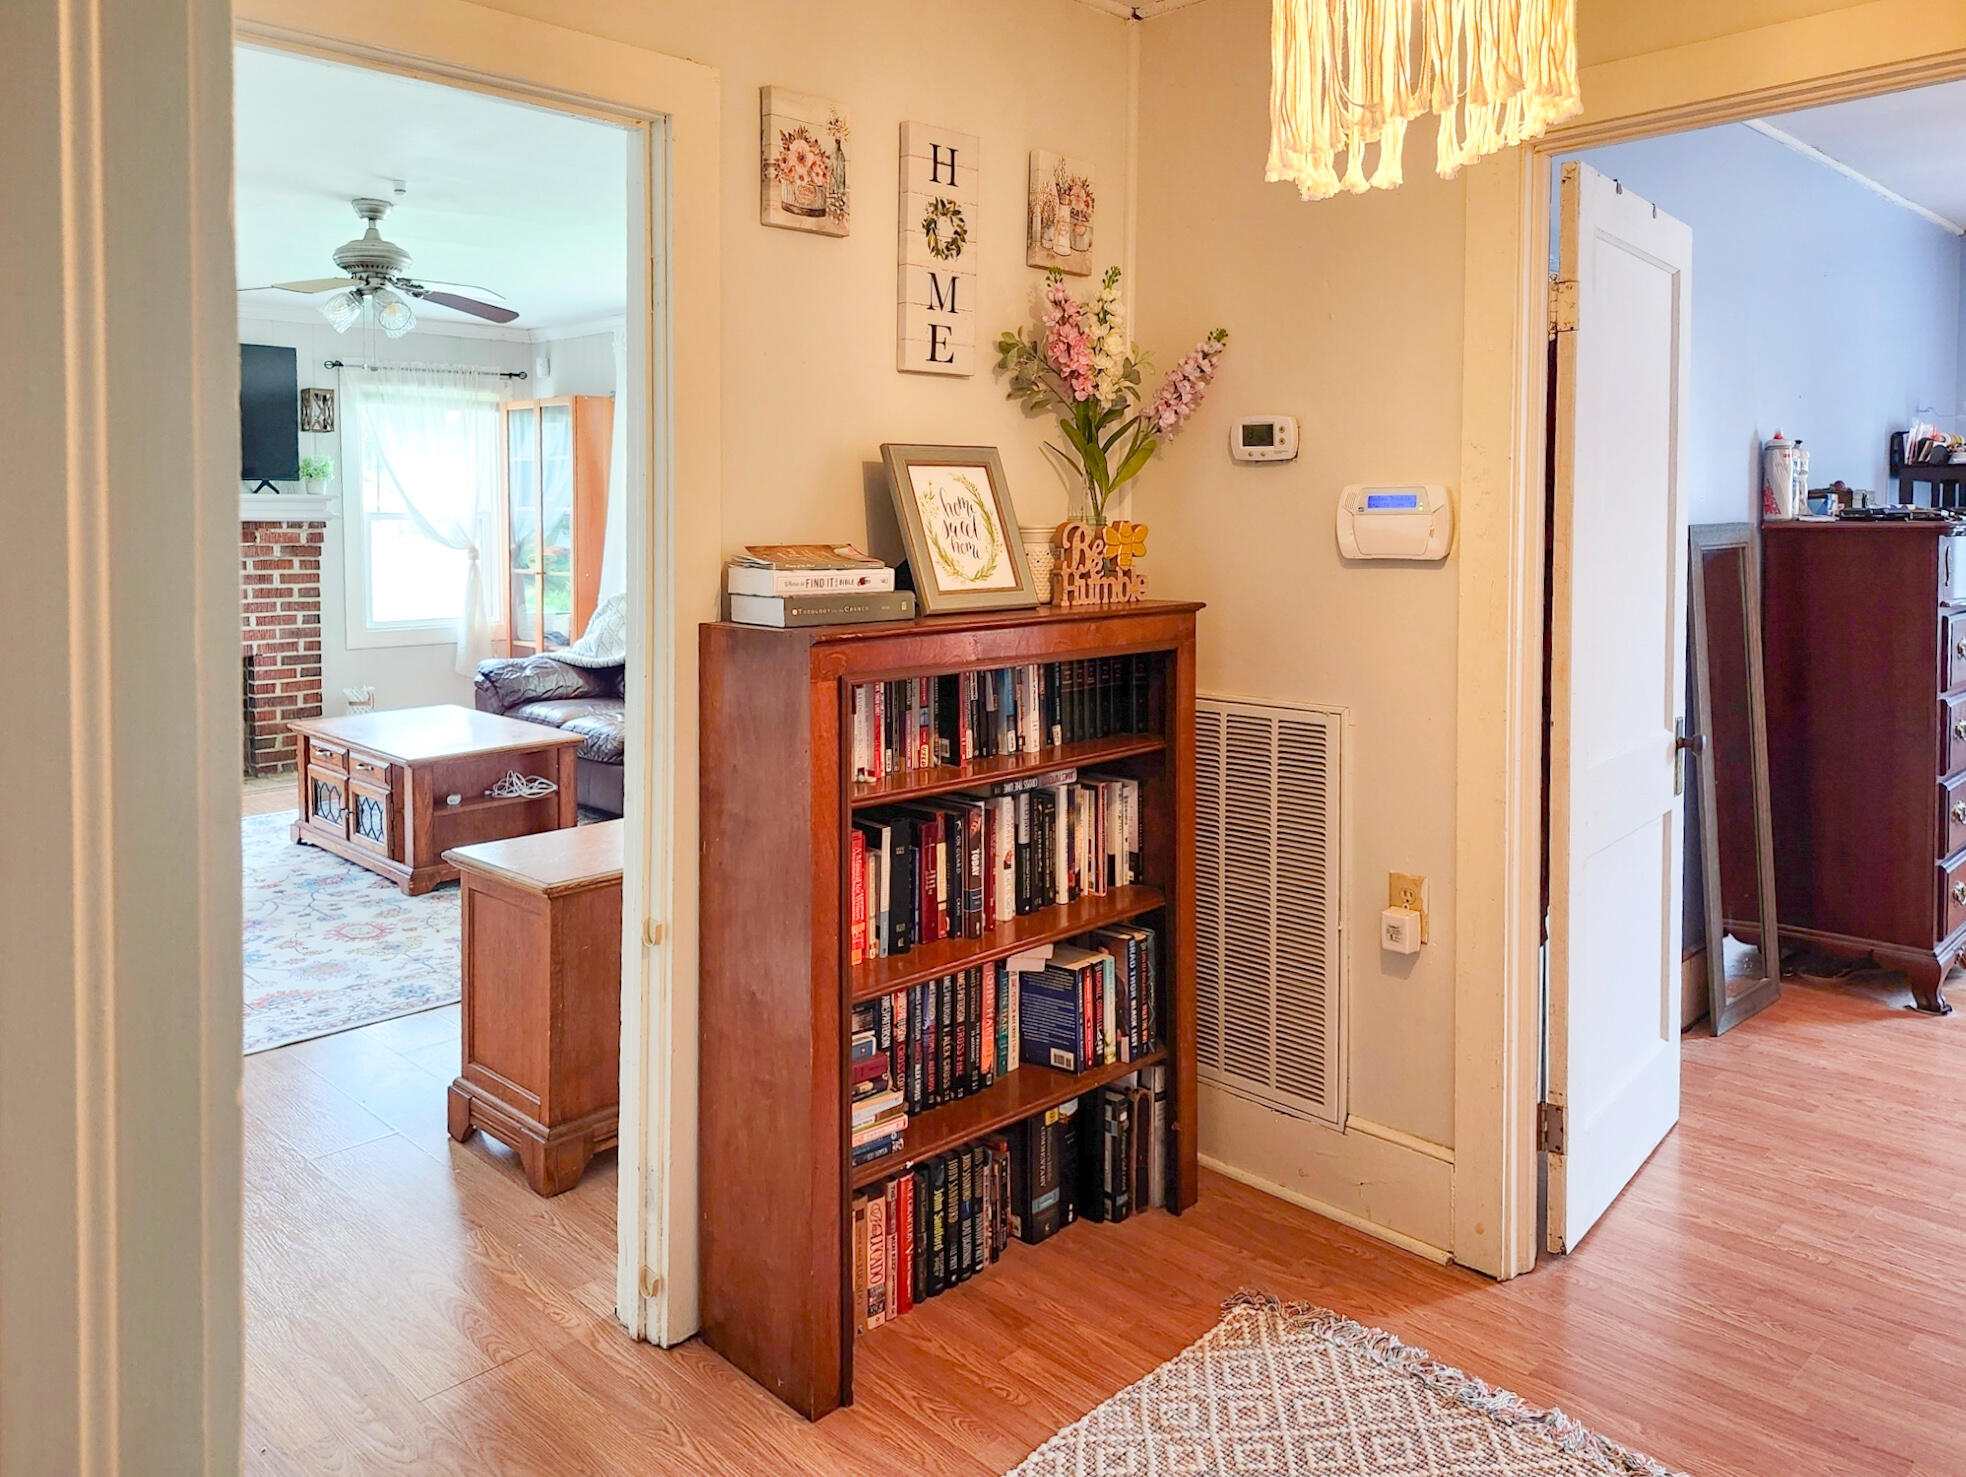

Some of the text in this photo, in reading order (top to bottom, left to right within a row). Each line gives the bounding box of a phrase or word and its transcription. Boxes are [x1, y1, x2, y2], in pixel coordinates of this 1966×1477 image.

[938, 487, 976, 518] home
[942, 515, 979, 541] sweet
[950, 537, 981, 560] home
[805, 577, 825, 589] FIND
[826, 576, 834, 589] IT
[1060, 565, 1148, 607] Humble
[971, 848, 980, 876] TODAY
[1129, 940, 1137, 968] BRAD
[1000, 977, 1008, 1005] JOHN
[1129, 970, 1138, 999] THOR
[985, 971, 995, 1041] JOHN HART
[1000, 1008, 1008, 1036] HART
[942, 1036, 951, 1058] ALEX
[956, 1025, 965, 1056] CROSS
[897, 1045, 906, 1074] CROSS
[942, 1058, 951, 1088] CROSS
[947, 1159, 959, 1182] JOHN
[1039, 1126, 1047, 1187] COMMENTARY
[933, 1188, 945, 1212] John
[947, 1181, 959, 1224] SANDFORD
[933, 1211, 945, 1251] Sandford
